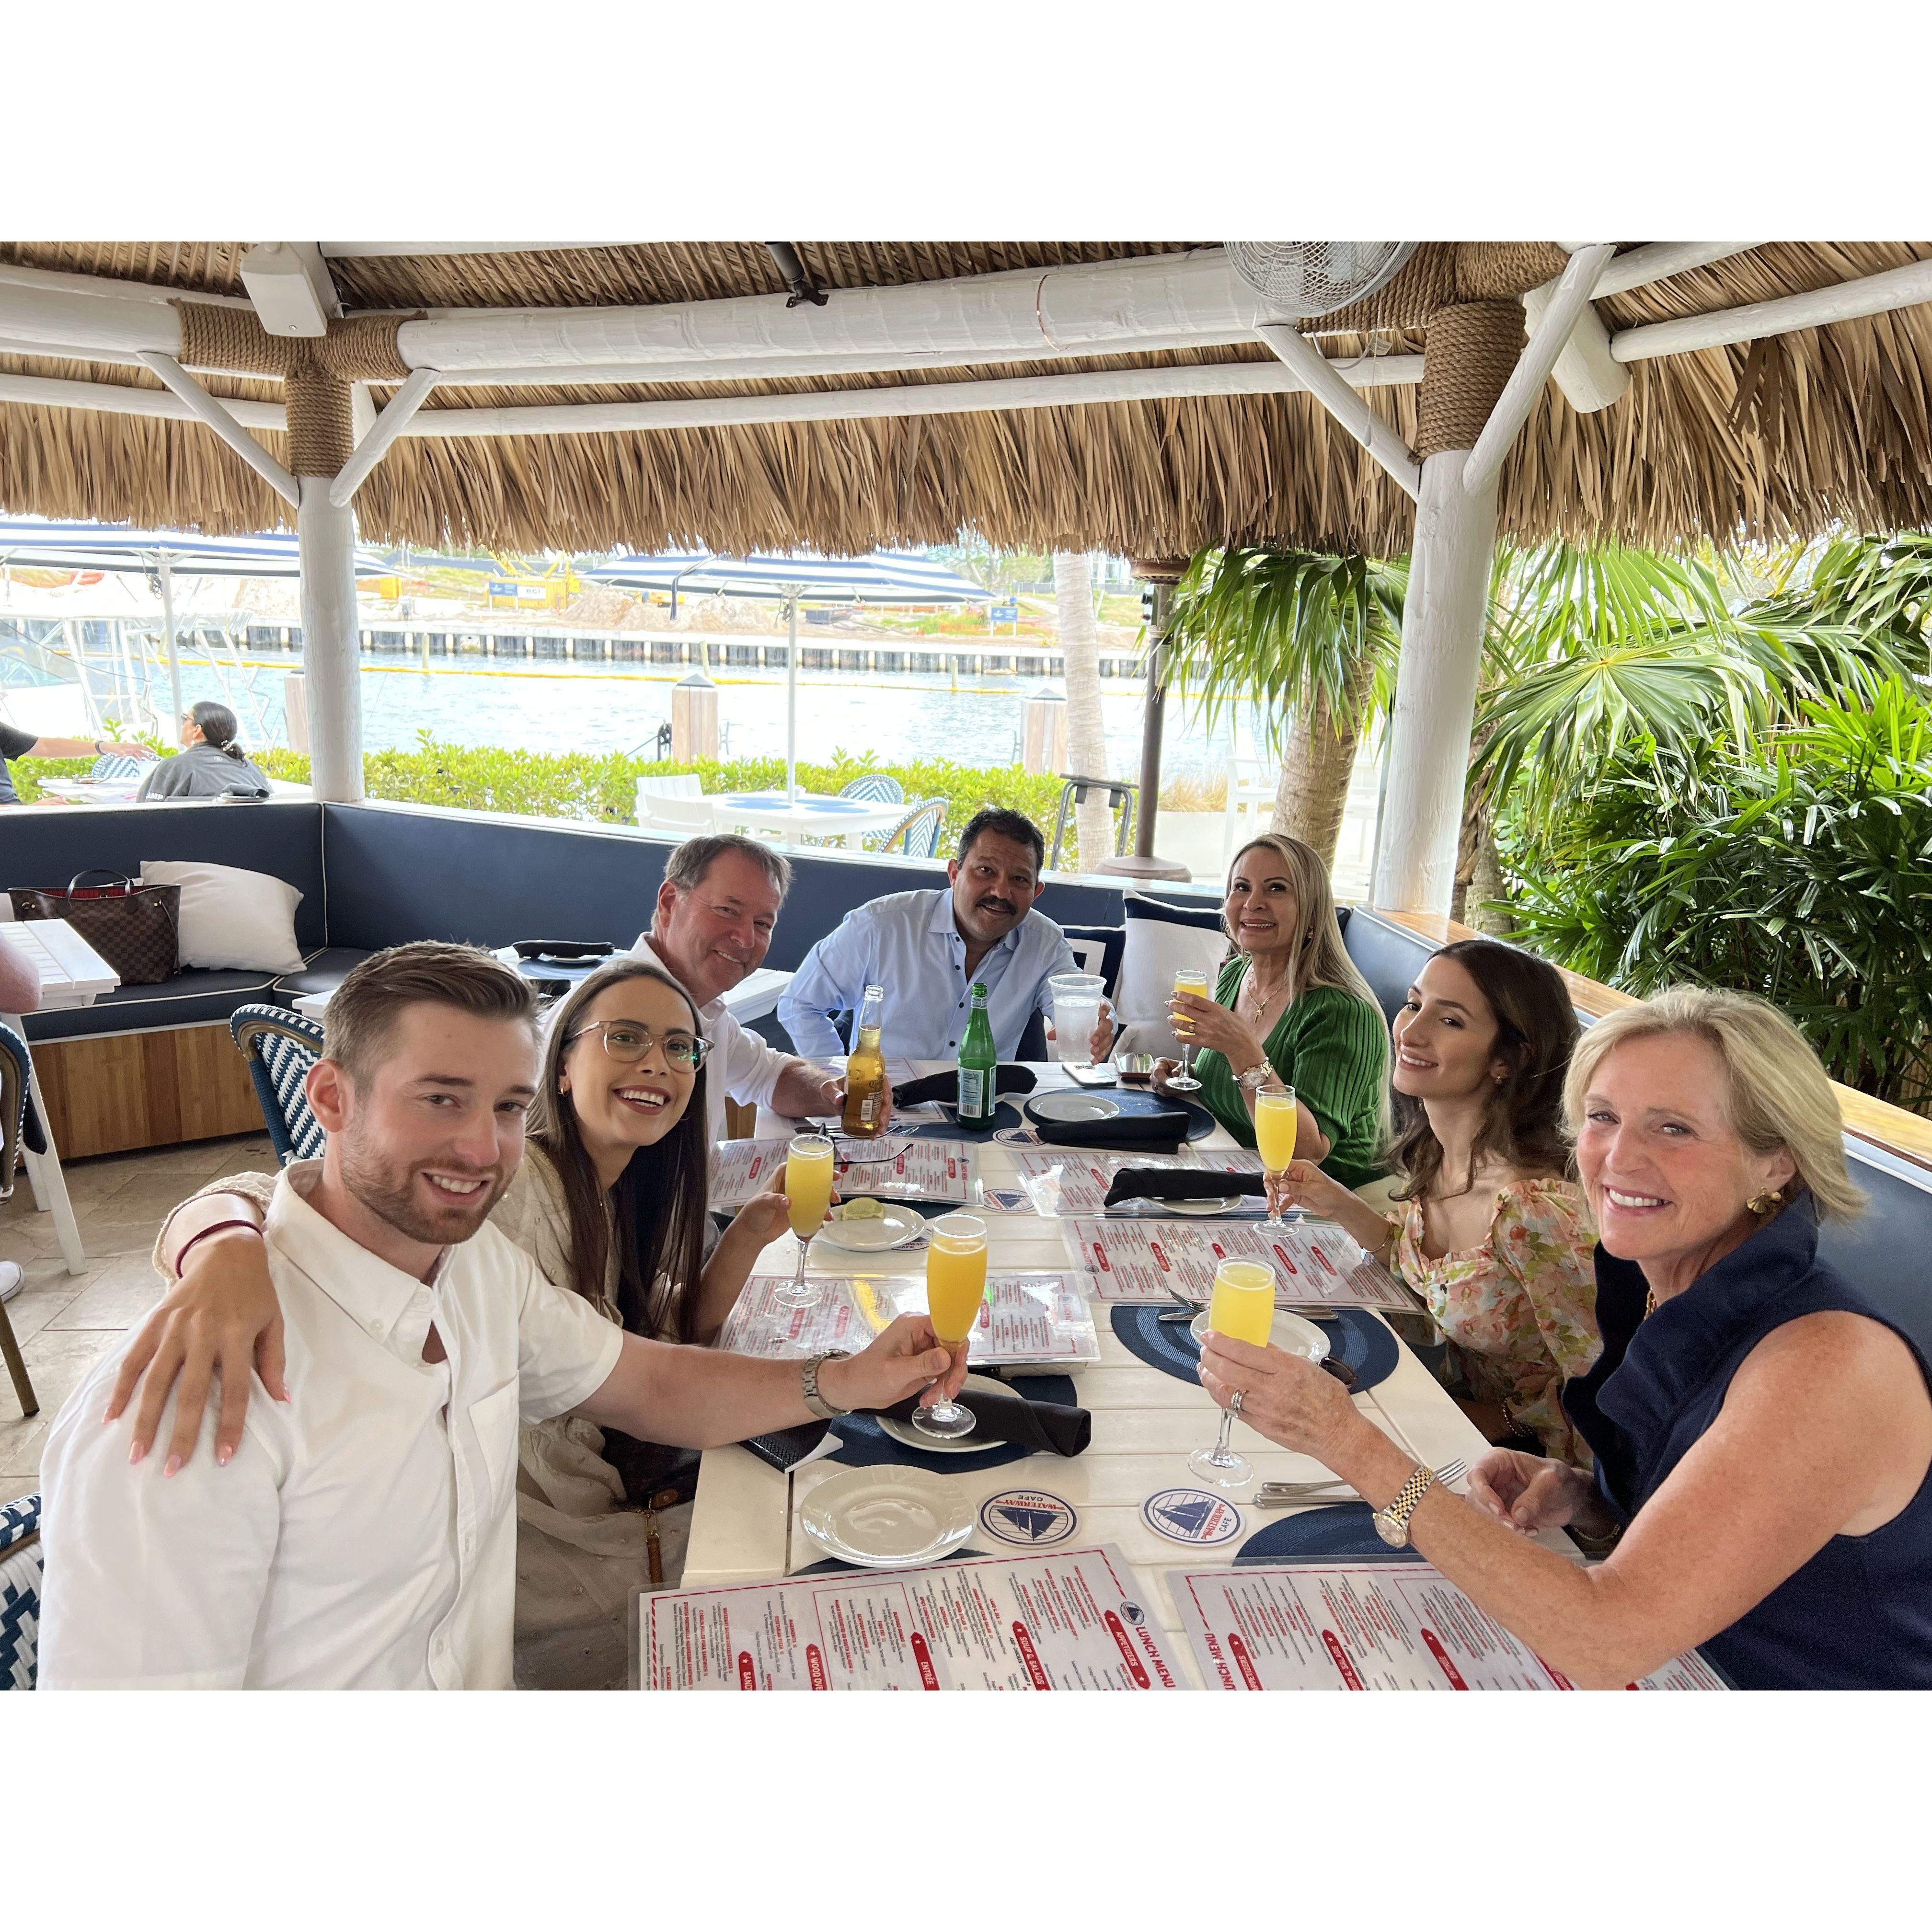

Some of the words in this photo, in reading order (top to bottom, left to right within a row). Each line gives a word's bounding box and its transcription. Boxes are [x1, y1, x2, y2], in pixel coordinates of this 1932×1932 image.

[1078, 1241, 1088, 1252] MENU
[1082, 1252, 1092, 1264] LUNCH
[998, 1499, 1062, 1509] WATERWAY
[1202, 1504, 1226, 1540] WATERWAY
[1218, 1515, 1232, 1533] CAFE
[893, 1612, 901, 1627] SEAFOOD
[926, 1621, 935, 1638] CHOWDER
[861, 1631, 869, 1647] RIGATONI
[1203, 1632, 1224, 1660] MENU
[1013, 1648, 1023, 1663] CHICKEN
[1115, 1632, 1138, 1666] APPETIZERS
[1134, 1627, 1160, 1657] LUNCH
[1150, 1659, 1176, 1688] MENU
[810, 1657, 821, 1677] WOOD
[1019, 1636, 1032, 1652] SOUP
[1028, 1660, 1045, 1684] SALADS
[920, 1661, 936, 1683] ENTRÉE
